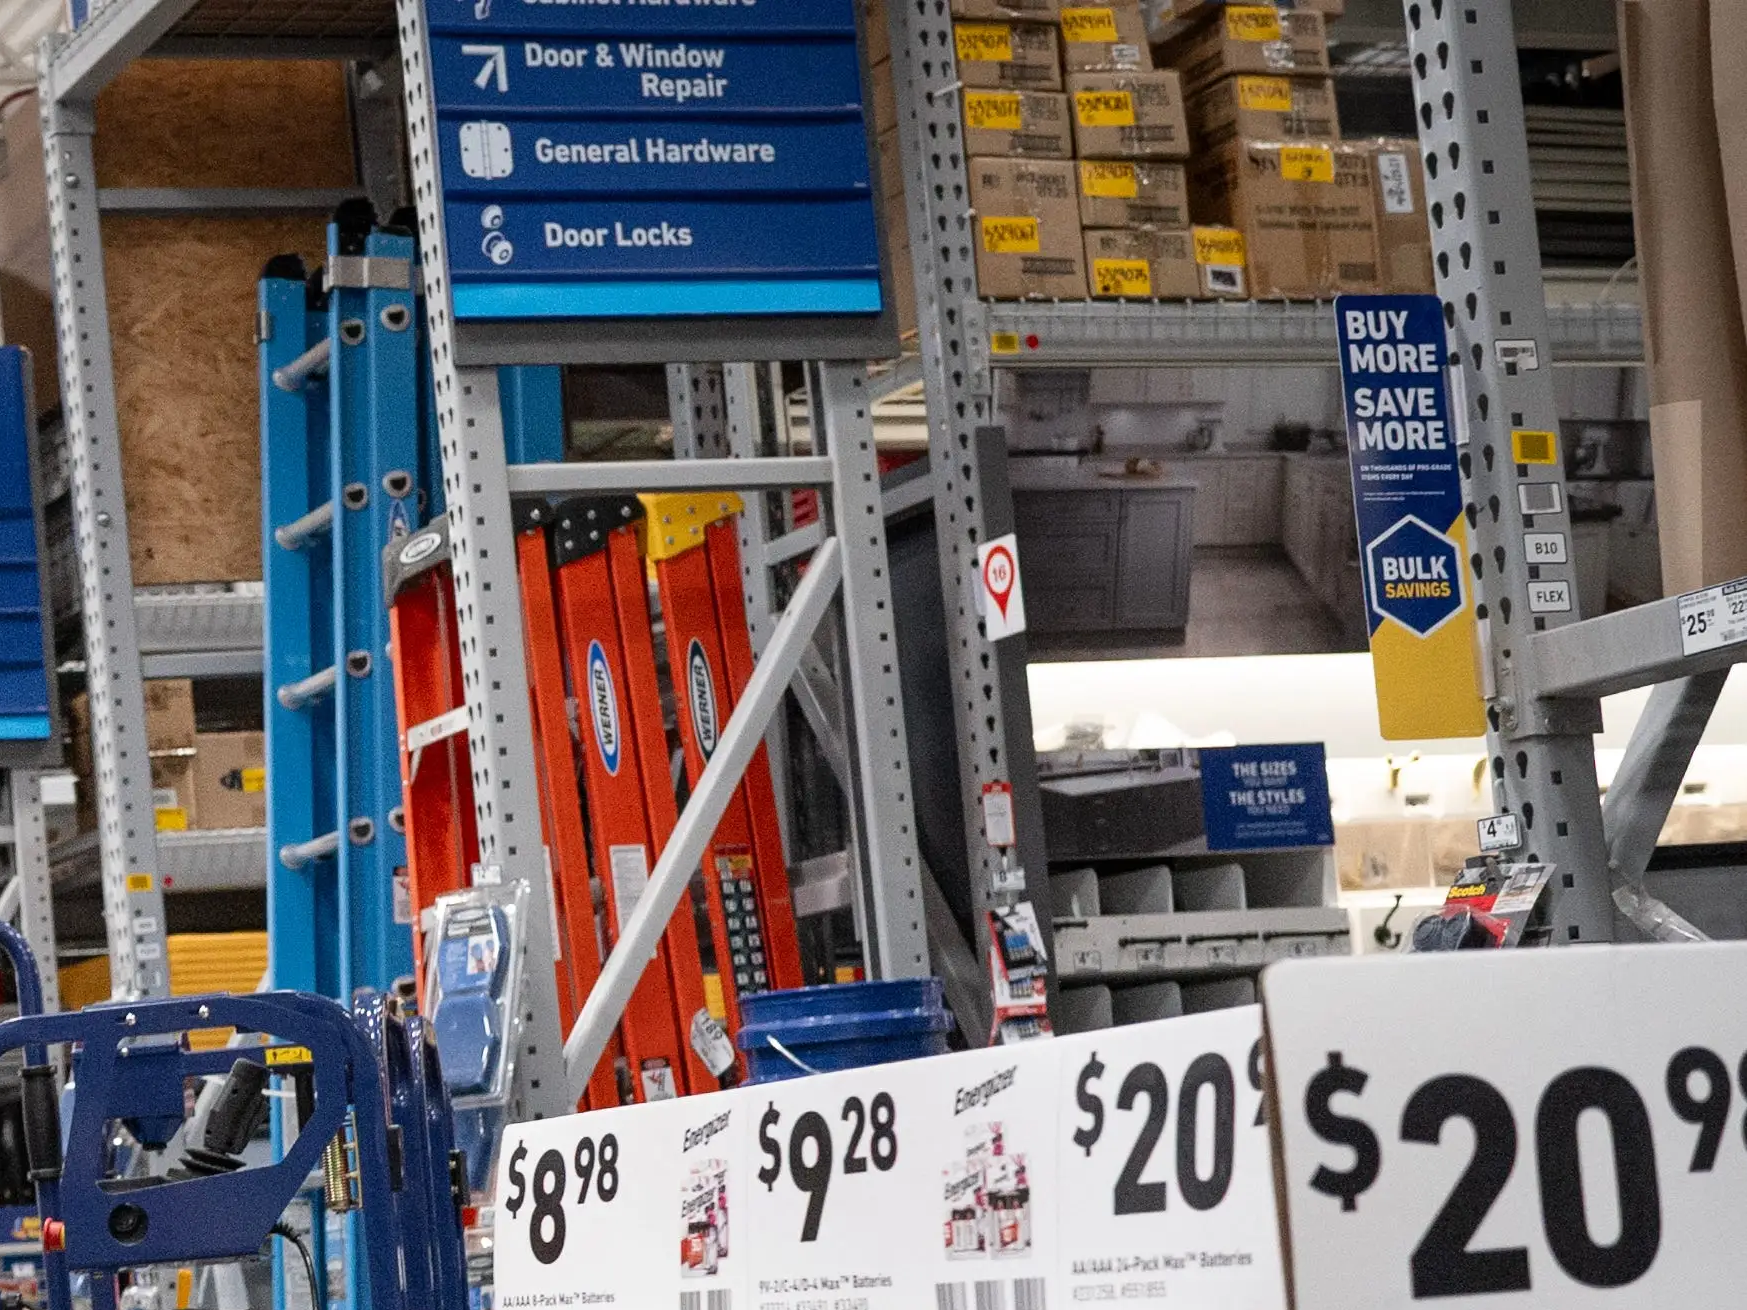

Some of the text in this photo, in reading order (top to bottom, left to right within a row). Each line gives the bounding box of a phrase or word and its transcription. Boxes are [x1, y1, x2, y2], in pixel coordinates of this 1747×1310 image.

[525, 42, 725, 68] Door & Window
[641, 73, 728, 100] Repair
[535, 137, 776, 164] General Hardware
[544, 222, 693, 248] Door Locks
[1345, 310, 1409, 341] BUY
[1349, 343, 1440, 375] MORE
[1354, 387, 1437, 418] SAVE
[1357, 420, 1447, 451] MORE
[1534, 542, 1559, 555] B10
[992, 564, 1007, 583] 16
[1382, 556, 1451, 581] BULK
[1384, 582, 1452, 599] SAVINGS
[1536, 590, 1565, 603] FLEX
[593, 668, 615, 747] WERNER
[691, 662, 713, 742] WERNER
[1231, 761, 1297, 778] THE SIZES
[1229, 788, 1306, 806] THE STYLES
[1449, 884, 1486, 898] Scotch
[954, 1065, 1018, 1116] Energizer
[682, 1109, 731, 1154] Energizer
[1199, 1251, 1253, 1268] Batteries
[852, 1274, 894, 1290] Batteries
[581, 1291, 615, 1305] Batteries
